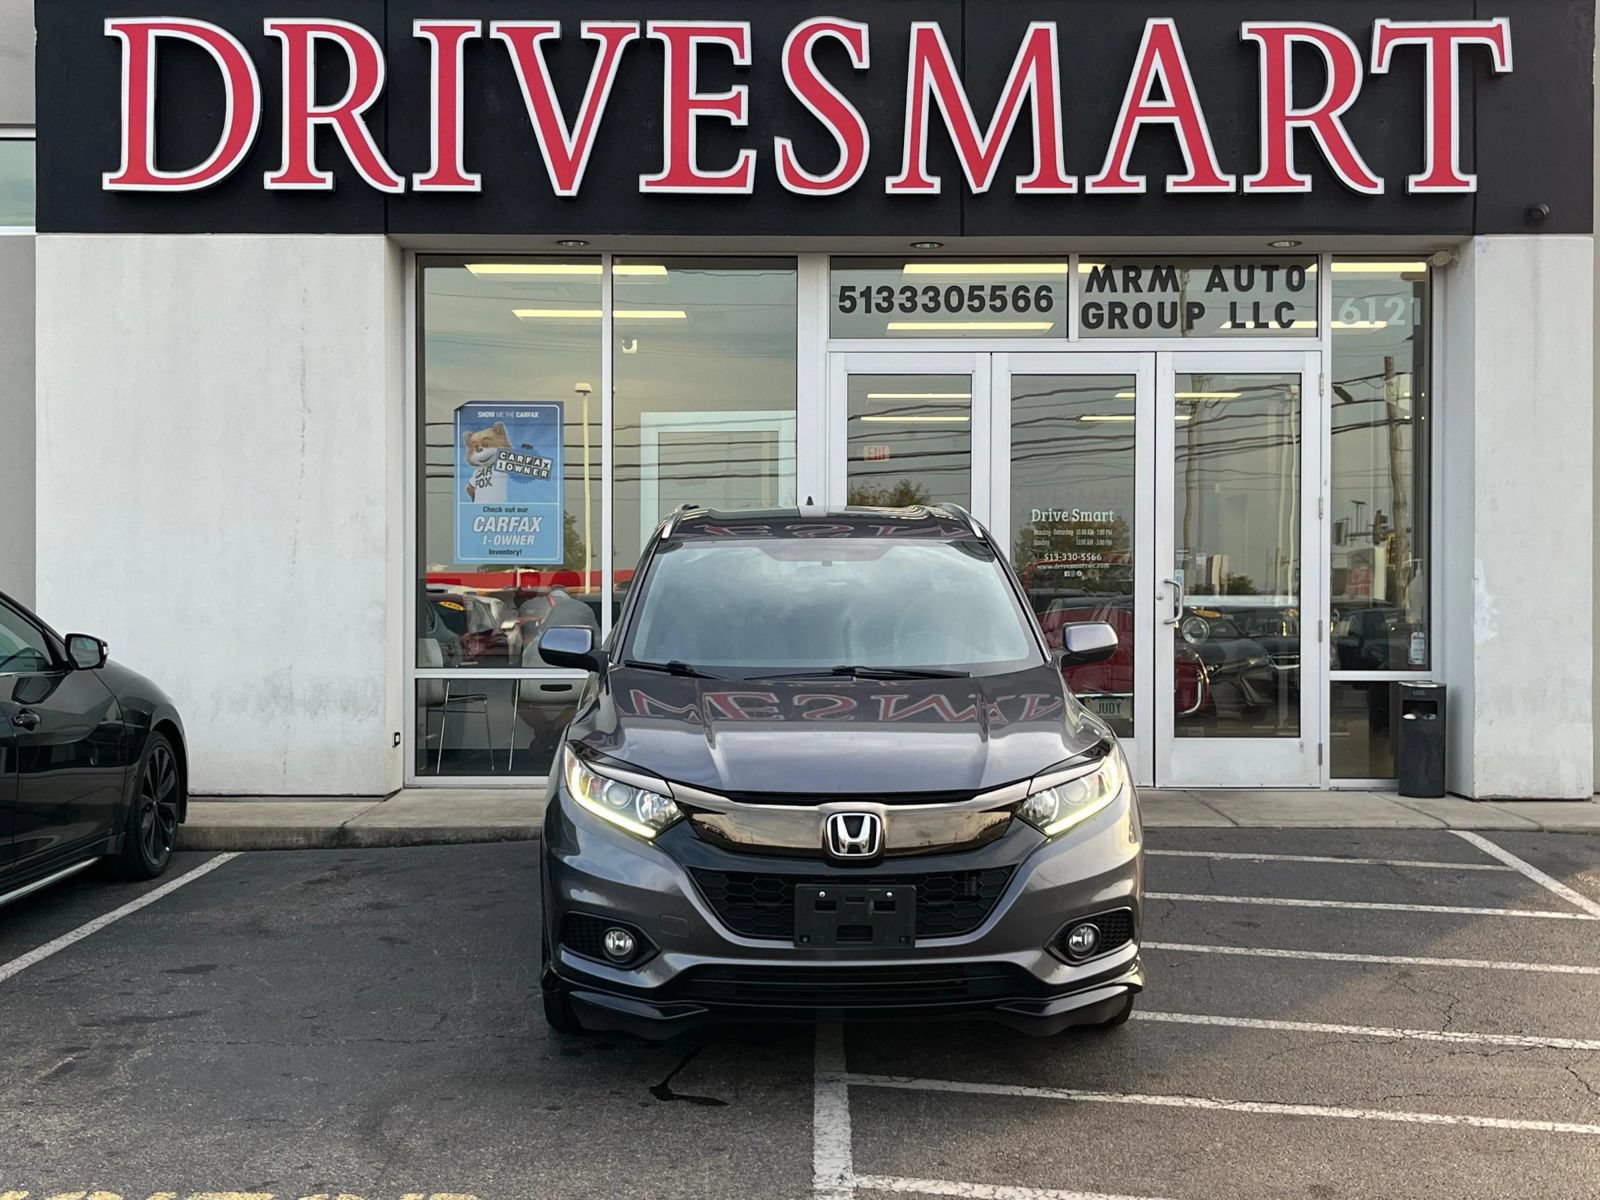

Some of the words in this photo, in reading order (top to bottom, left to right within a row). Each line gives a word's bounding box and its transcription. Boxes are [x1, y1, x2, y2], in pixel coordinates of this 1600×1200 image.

[103, 16, 1513, 197] DRIVESMART
[1085, 264, 1181, 294] MRM
[1205, 264, 1307, 293] AUTO
[838, 285, 1054, 314] 5133305566
[1081, 301, 1206, 330] GROUP
[1230, 301, 1296, 329] LLC
[1338, 296, 1421, 326] 6121
[500, 451, 551, 470] CARFAX
[507, 464, 549, 478] OWNER
[473, 515, 543, 532] CARFAX
[1031, 508, 1069, 522] Drive
[1071, 508, 1115, 522] Smart
[1044, 553, 1102, 561] 513-330-5566
[1096, 702, 1122, 714] JUDY
